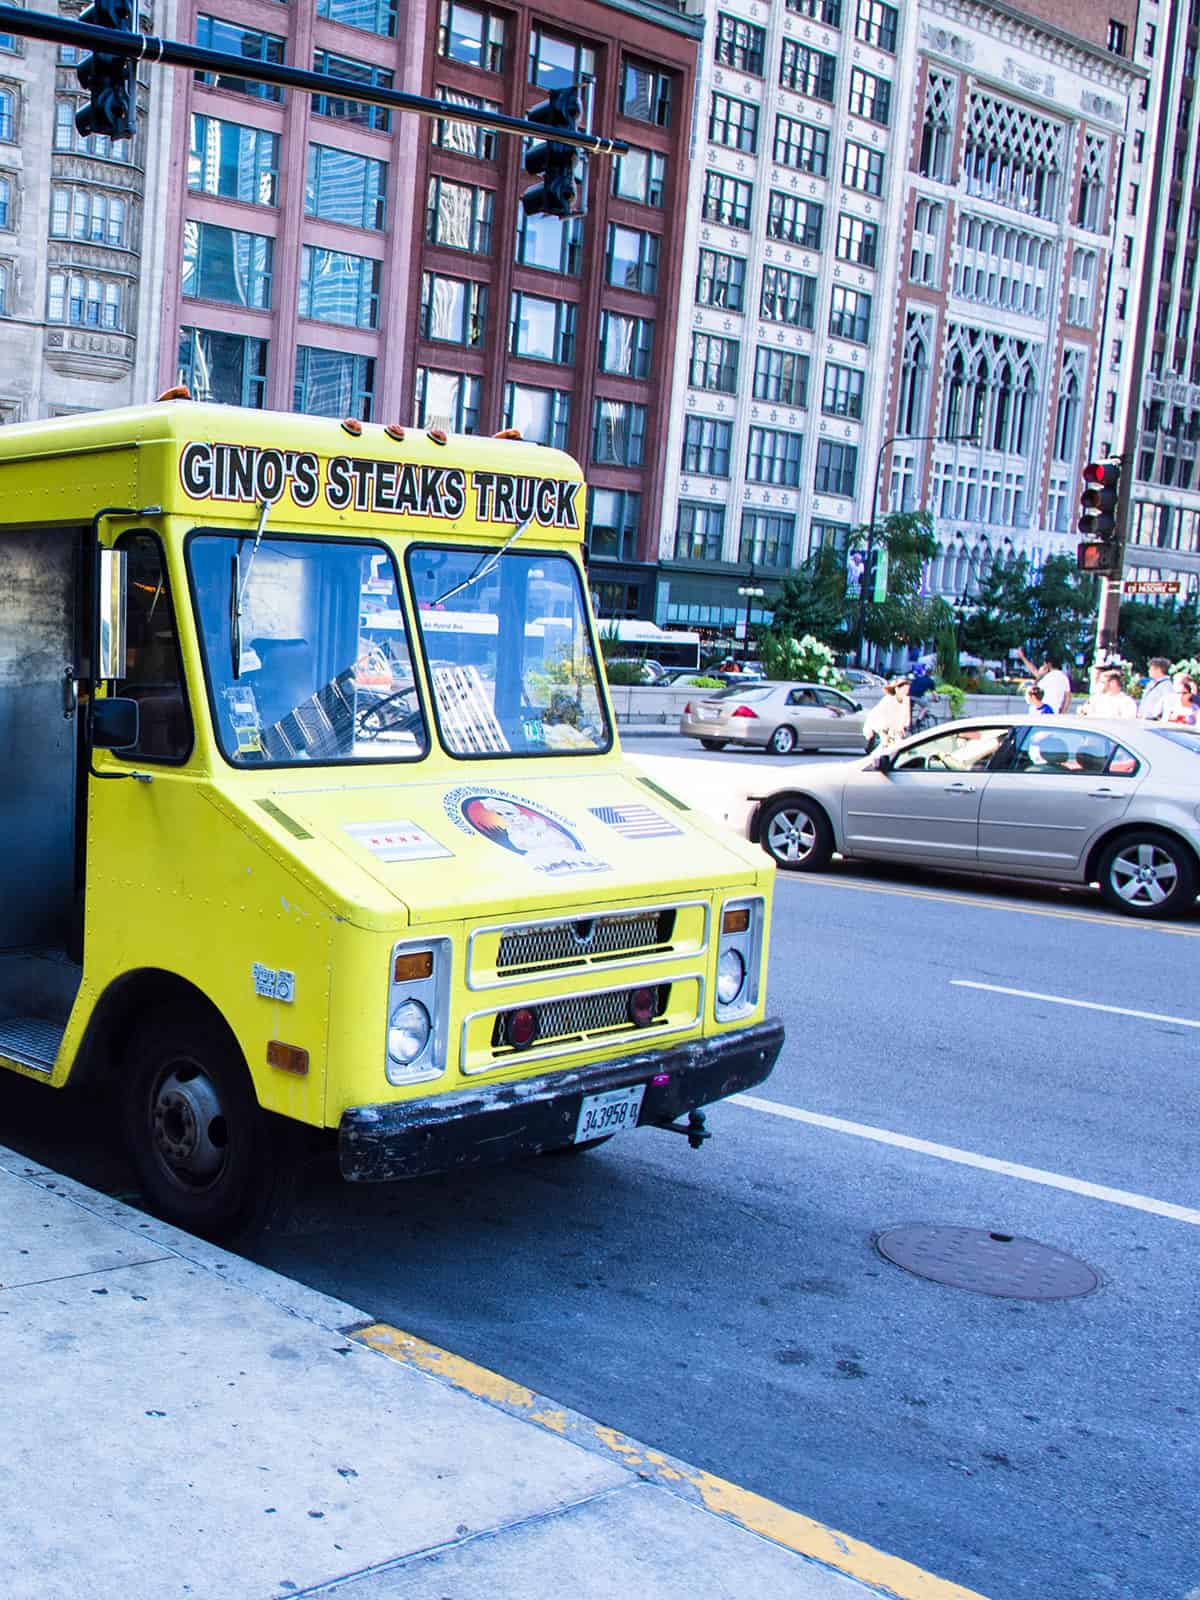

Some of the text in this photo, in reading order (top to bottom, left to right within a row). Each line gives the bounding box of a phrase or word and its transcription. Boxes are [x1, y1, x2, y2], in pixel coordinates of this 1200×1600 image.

[180, 441, 582, 528] GINO'S STEAKS TRUCK
[582, 1102, 628, 1133] 343958
